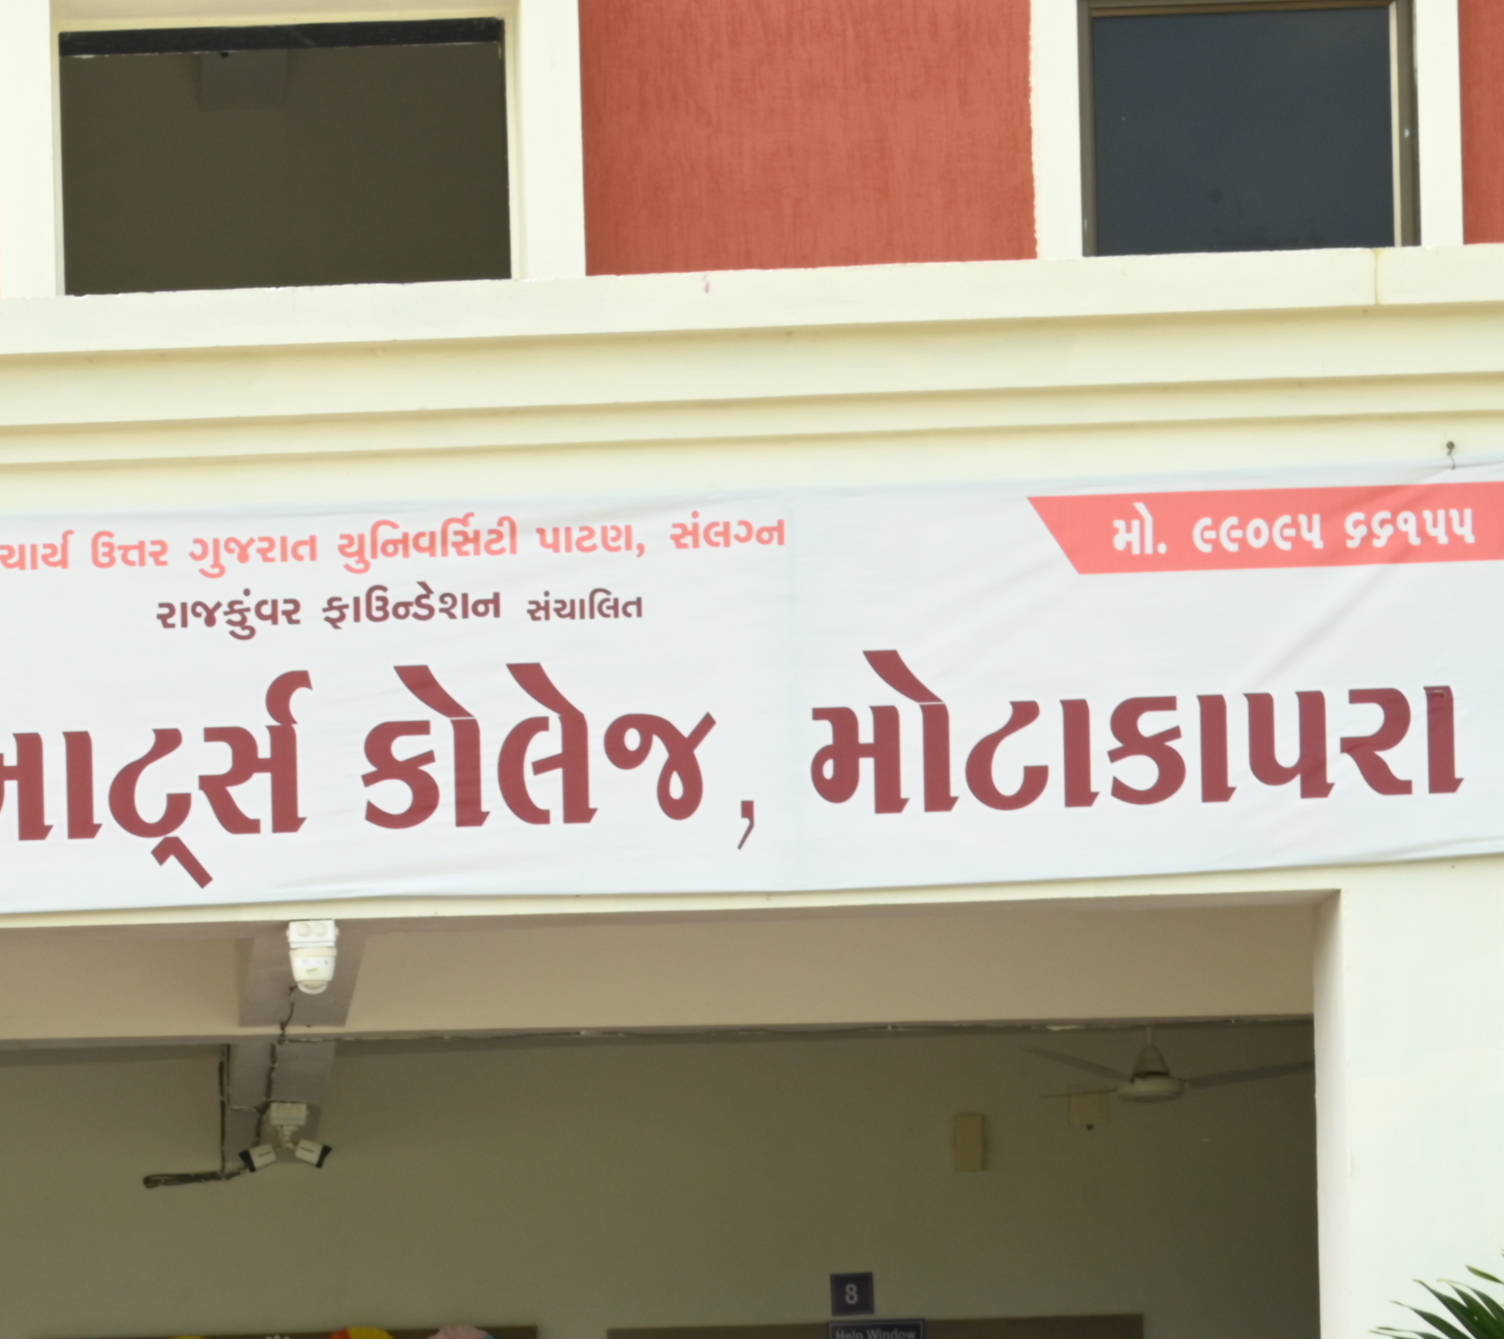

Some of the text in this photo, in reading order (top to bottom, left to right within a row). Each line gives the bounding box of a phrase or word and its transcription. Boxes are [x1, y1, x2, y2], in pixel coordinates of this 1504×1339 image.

[92, 531, 168, 568] ઉત્તર
[189, 535, 317, 578] ગુજરાત
[338, 512, 517, 574] યુનિવર્સિટી
[536, 525, 645, 557] પાટણ,
[670, 511, 785, 549] સંલગ્ન
[1114, 503, 1475, 554] મો. ૯૯૦૯૫ ૬૬૧૫૫
[156, 581, 642, 641] રાજકુંવર ફાઉન્ડેશન સંચાલિત
[810, 649, 1463, 814] મોટાકાપરા
[844, 1284, 858, 1304] 8
